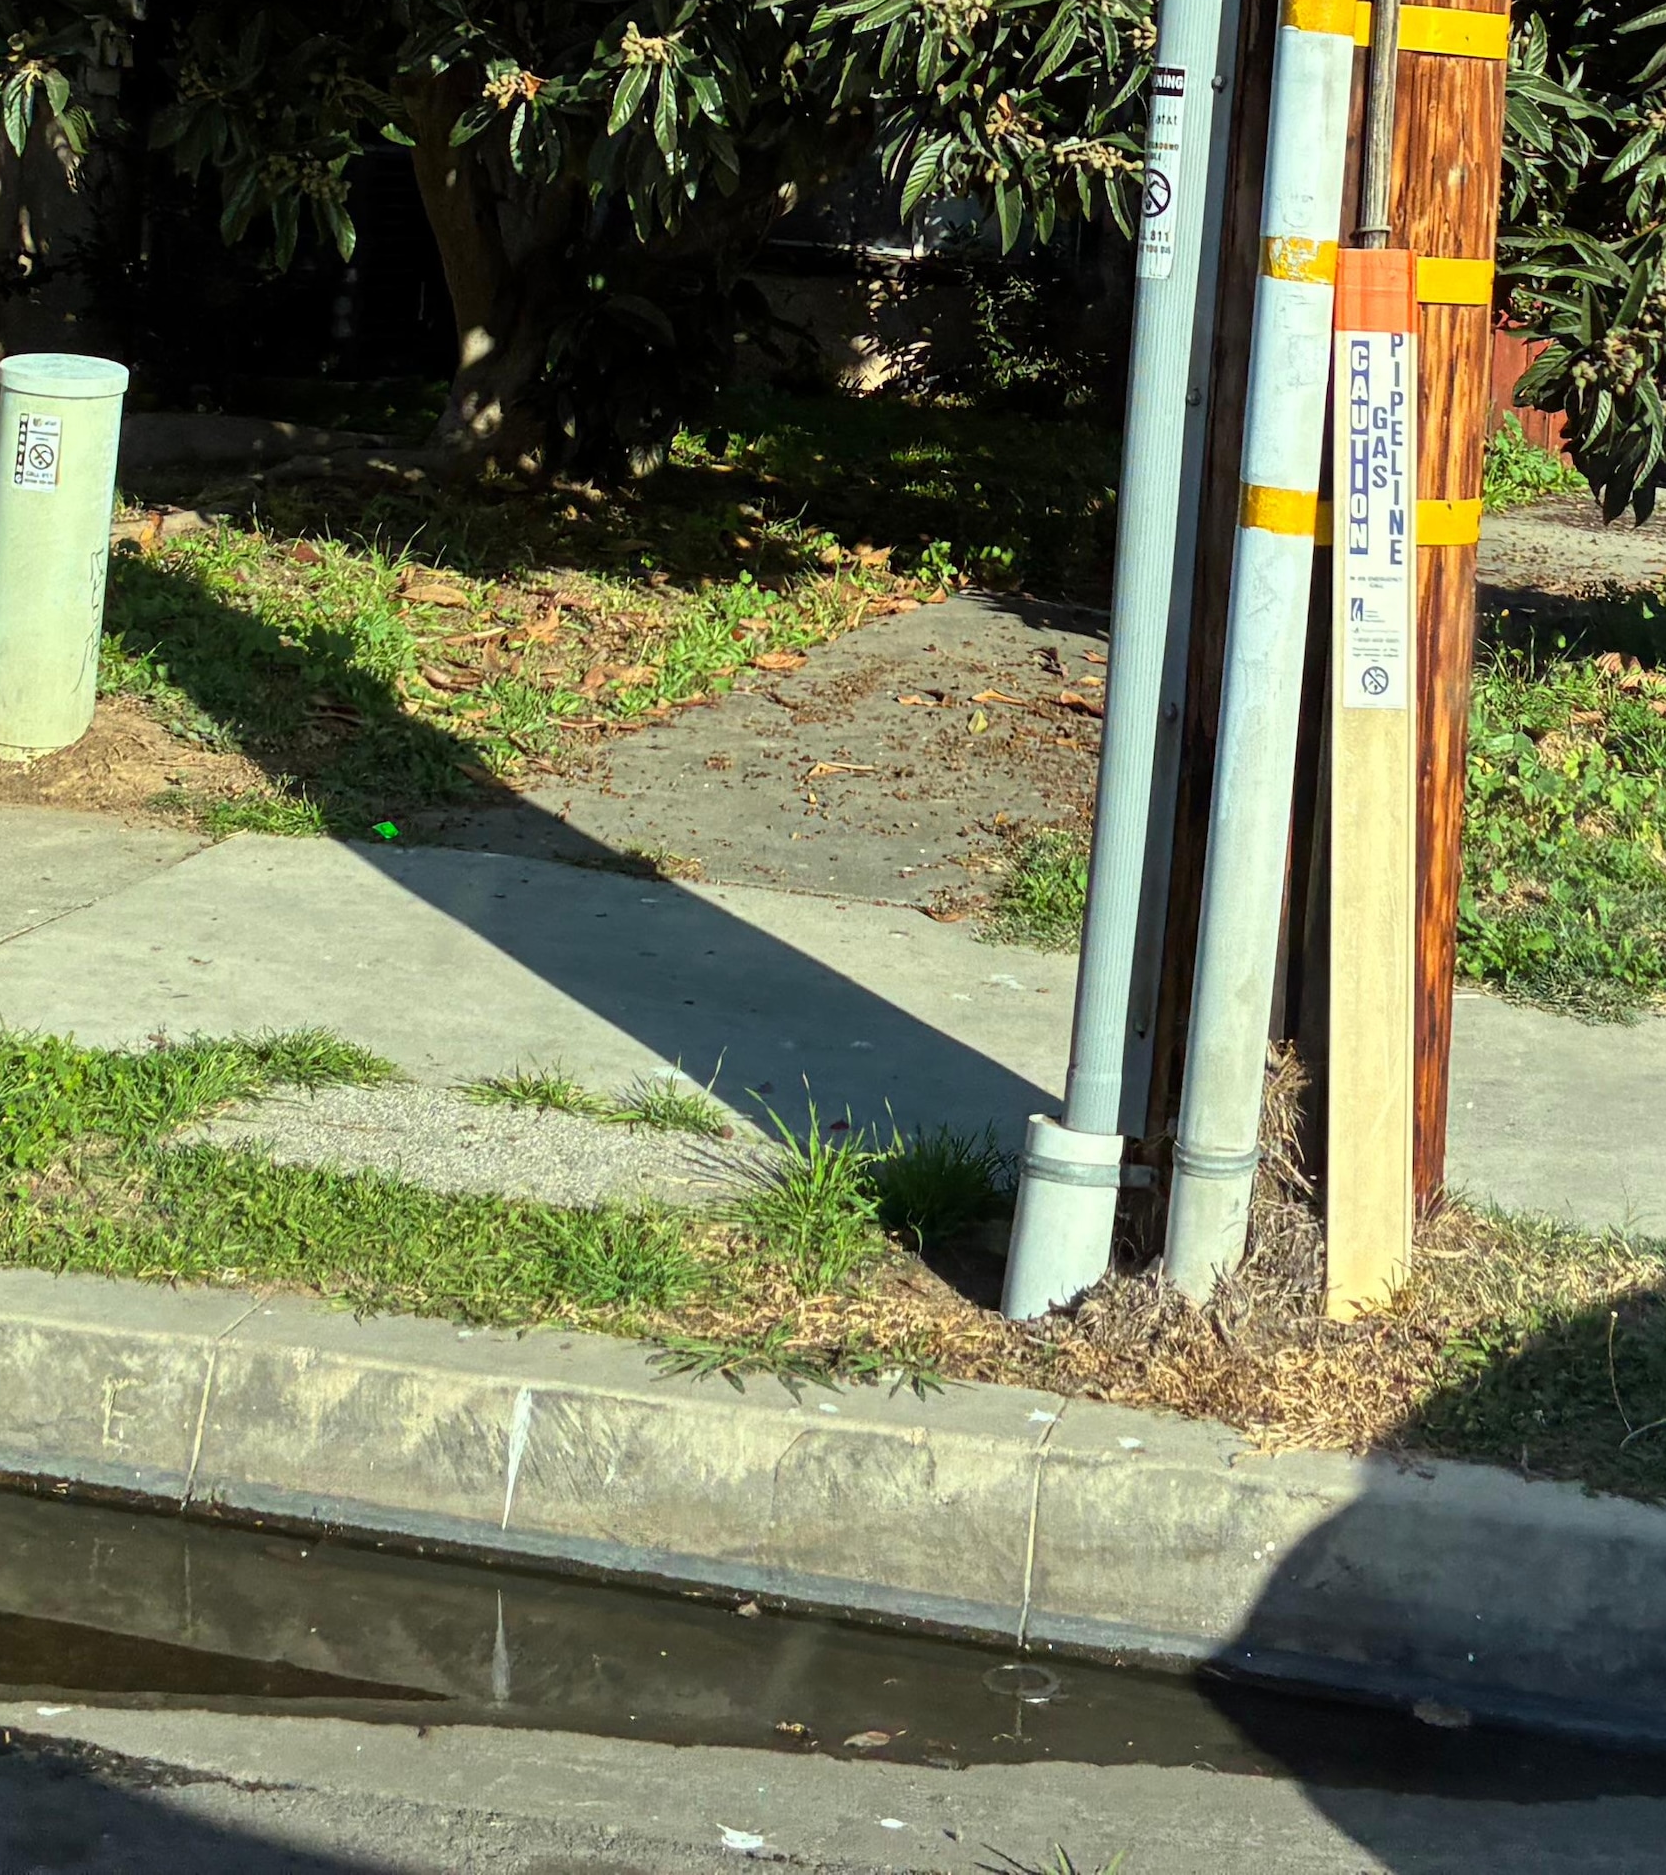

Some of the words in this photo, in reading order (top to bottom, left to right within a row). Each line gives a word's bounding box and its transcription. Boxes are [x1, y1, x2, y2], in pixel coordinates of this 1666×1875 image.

[1150, 230, 1169, 242] 811
[1350, 343, 1369, 550] CAUTION
[1372, 406, 1388, 489] GAS
[1389, 332, 1404, 565] PIPELINE
